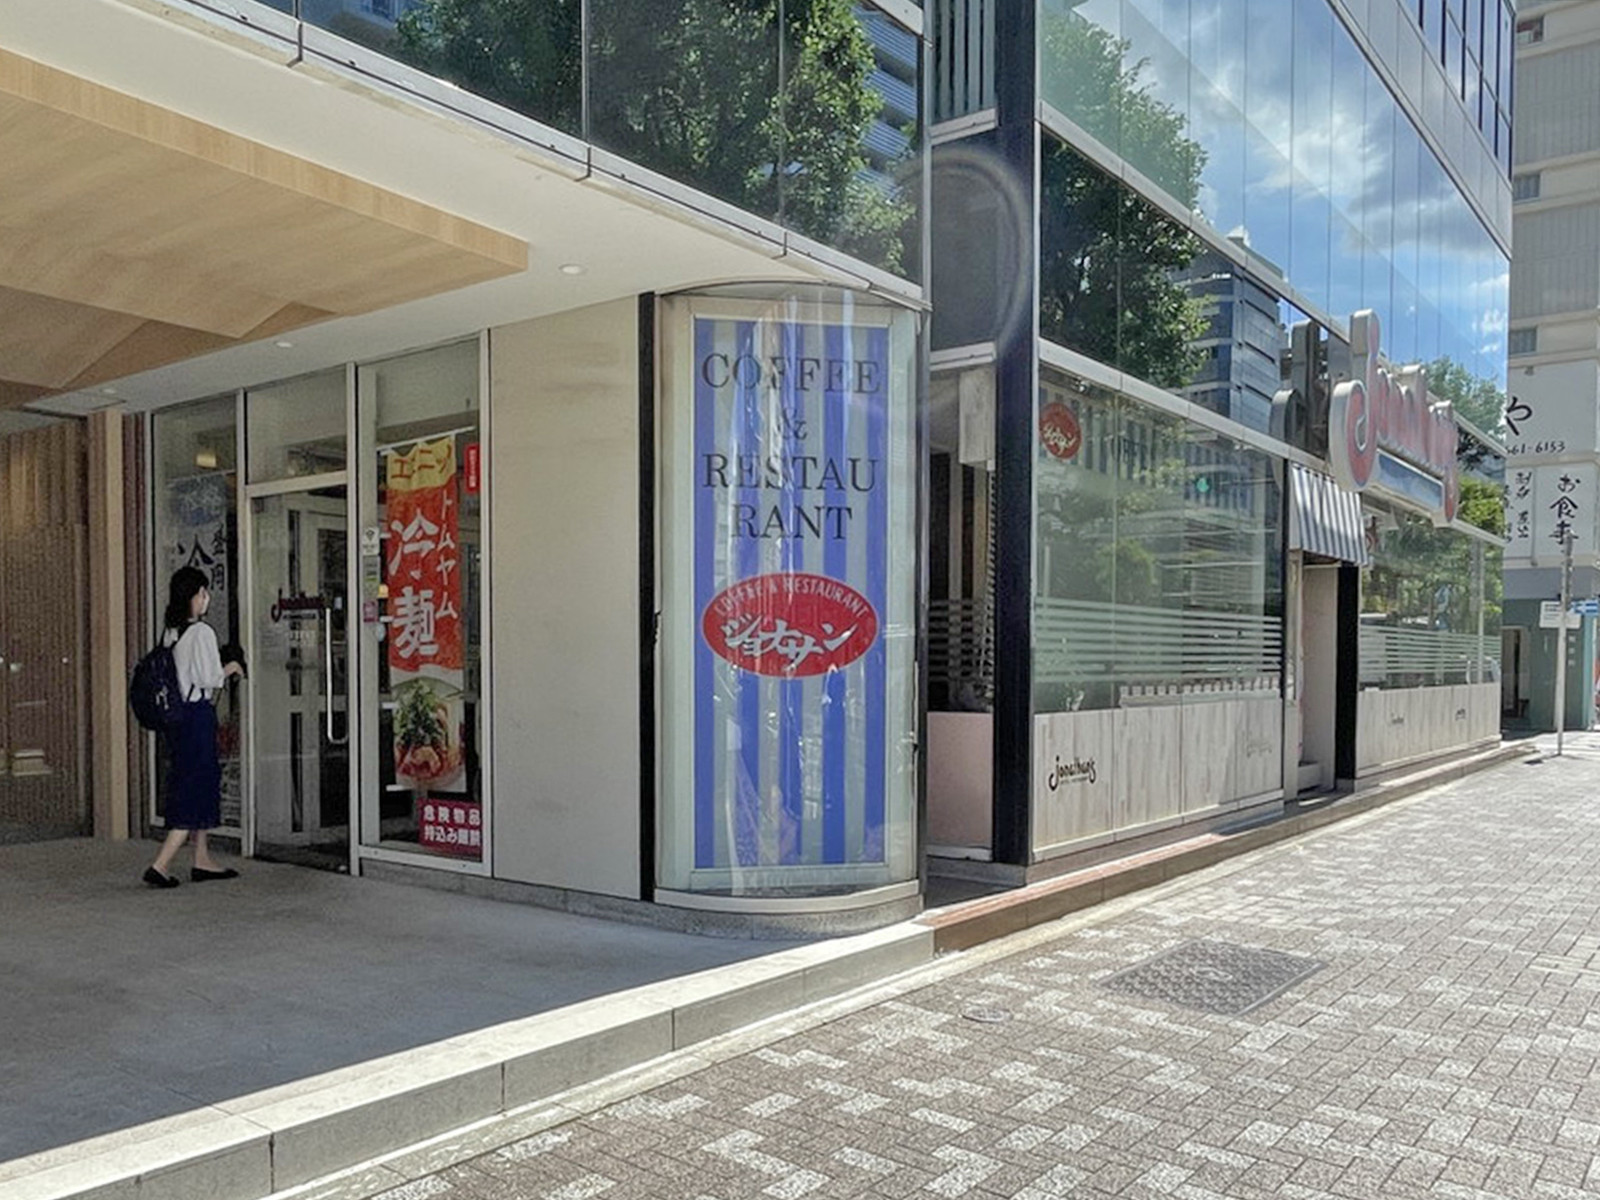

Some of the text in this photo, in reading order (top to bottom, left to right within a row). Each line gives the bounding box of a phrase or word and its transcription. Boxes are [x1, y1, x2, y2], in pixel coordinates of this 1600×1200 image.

[702, 352, 881, 395] COFFEE
[780, 407, 808, 441] &
[702, 453, 878, 492] RESTAU
[731, 503, 852, 540] RANT
[1549, 473, 1581, 545] お食事
[435, 488, 458, 619] トムヤム
[389, 507, 439, 659] 冷麺
[782, 575, 869, 618] RESTAURANT
[720, 613, 859, 672] ジョナサン
